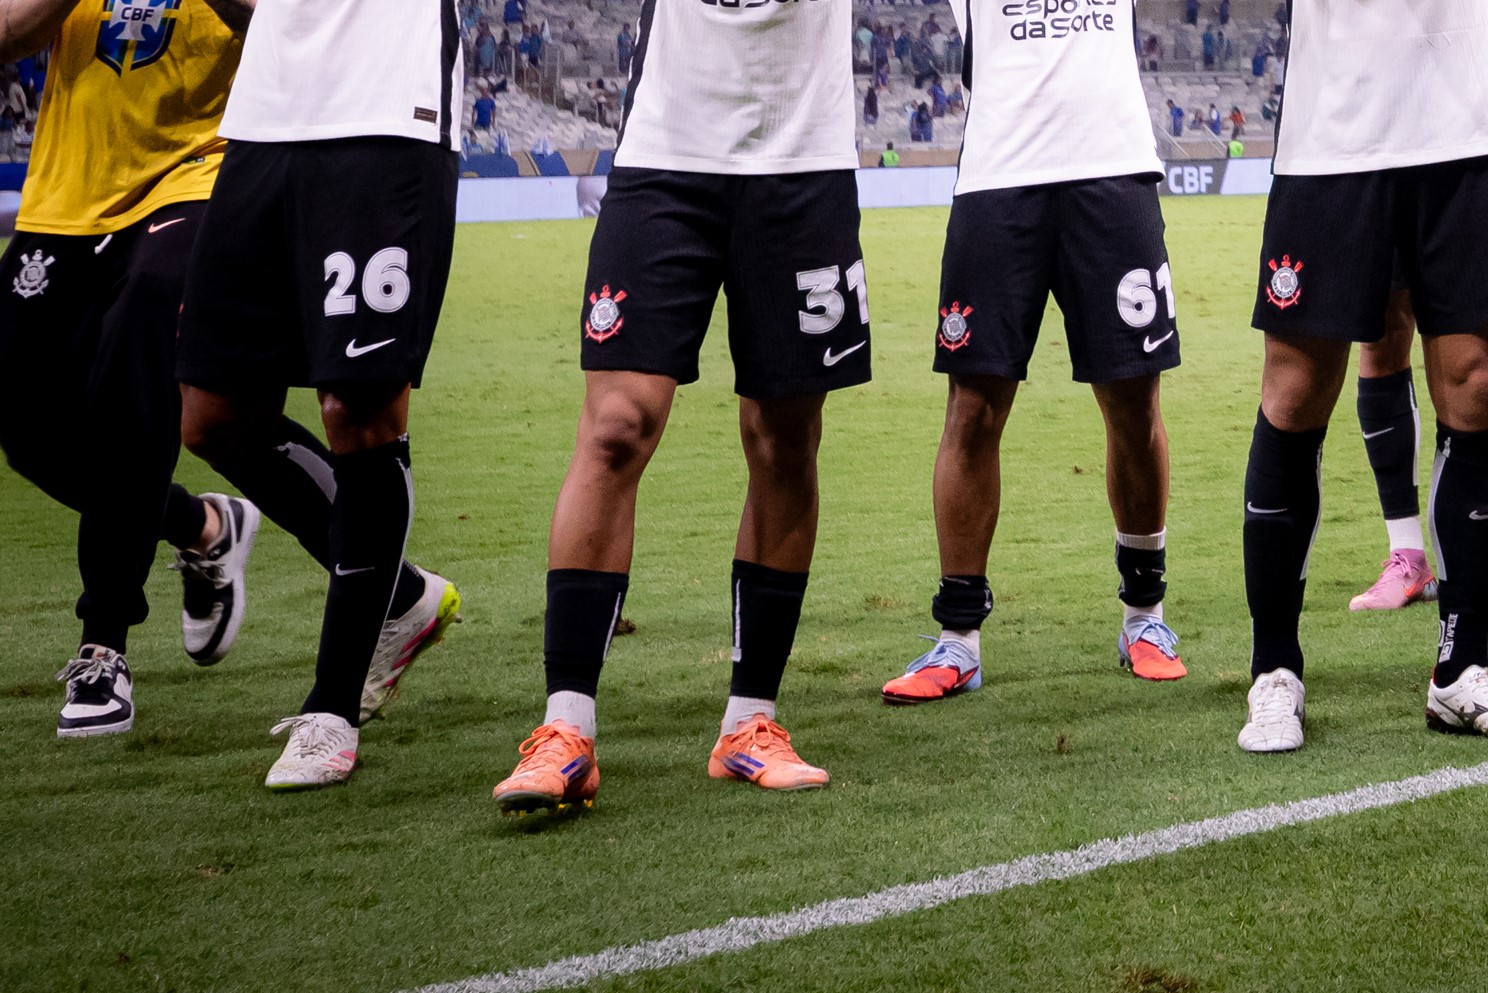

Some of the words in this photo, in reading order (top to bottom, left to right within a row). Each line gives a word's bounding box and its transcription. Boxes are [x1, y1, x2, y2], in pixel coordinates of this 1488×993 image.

[121, 6, 154, 22] CBF
[1009, 19, 1047, 41] da
[1049, 9, 1116, 39] Sorte
[1167, 165, 1214, 195] CBF
[323, 246, 411, 317] 26
[796, 258, 870, 335] 31
[1116, 261, 1177, 328] 61
